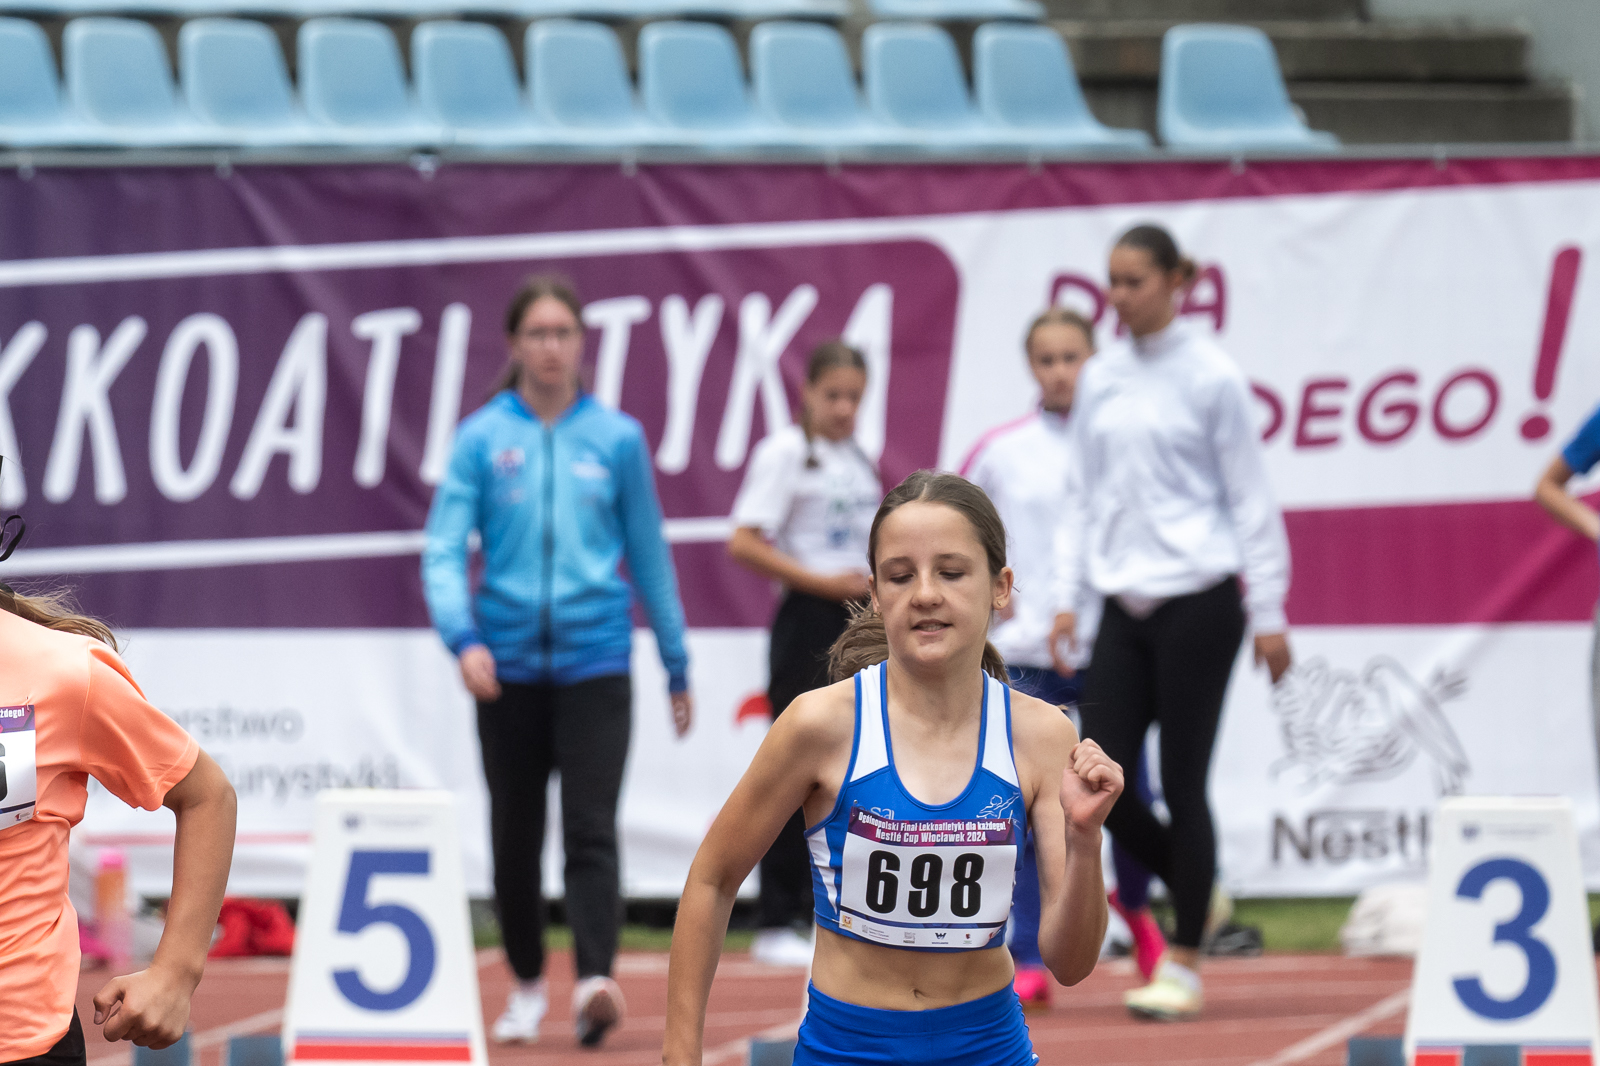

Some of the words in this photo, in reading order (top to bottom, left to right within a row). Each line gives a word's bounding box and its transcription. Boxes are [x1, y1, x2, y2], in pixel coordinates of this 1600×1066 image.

[1049, 262, 1228, 337] DA
[1250, 243, 1585, 451] DEGO!
[858, 811, 899, 831] Ogólnopolski
[900, 822, 918, 832] Finał
[918, 821, 965, 833] Lekkoatletyki
[965, 821, 977, 831] dla
[977, 820, 1007, 832] każdego!
[875, 827, 902, 842] Nestlé
[903, 832, 919, 844] Cup
[921, 831, 966, 843] Włocławek
[966, 831, 987, 842] 2024
[1270, 808, 1431, 865] Nestl
[865, 850, 985, 918] 698
[332, 849, 437, 1013] 5
[1452, 857, 1557, 1022] 3
